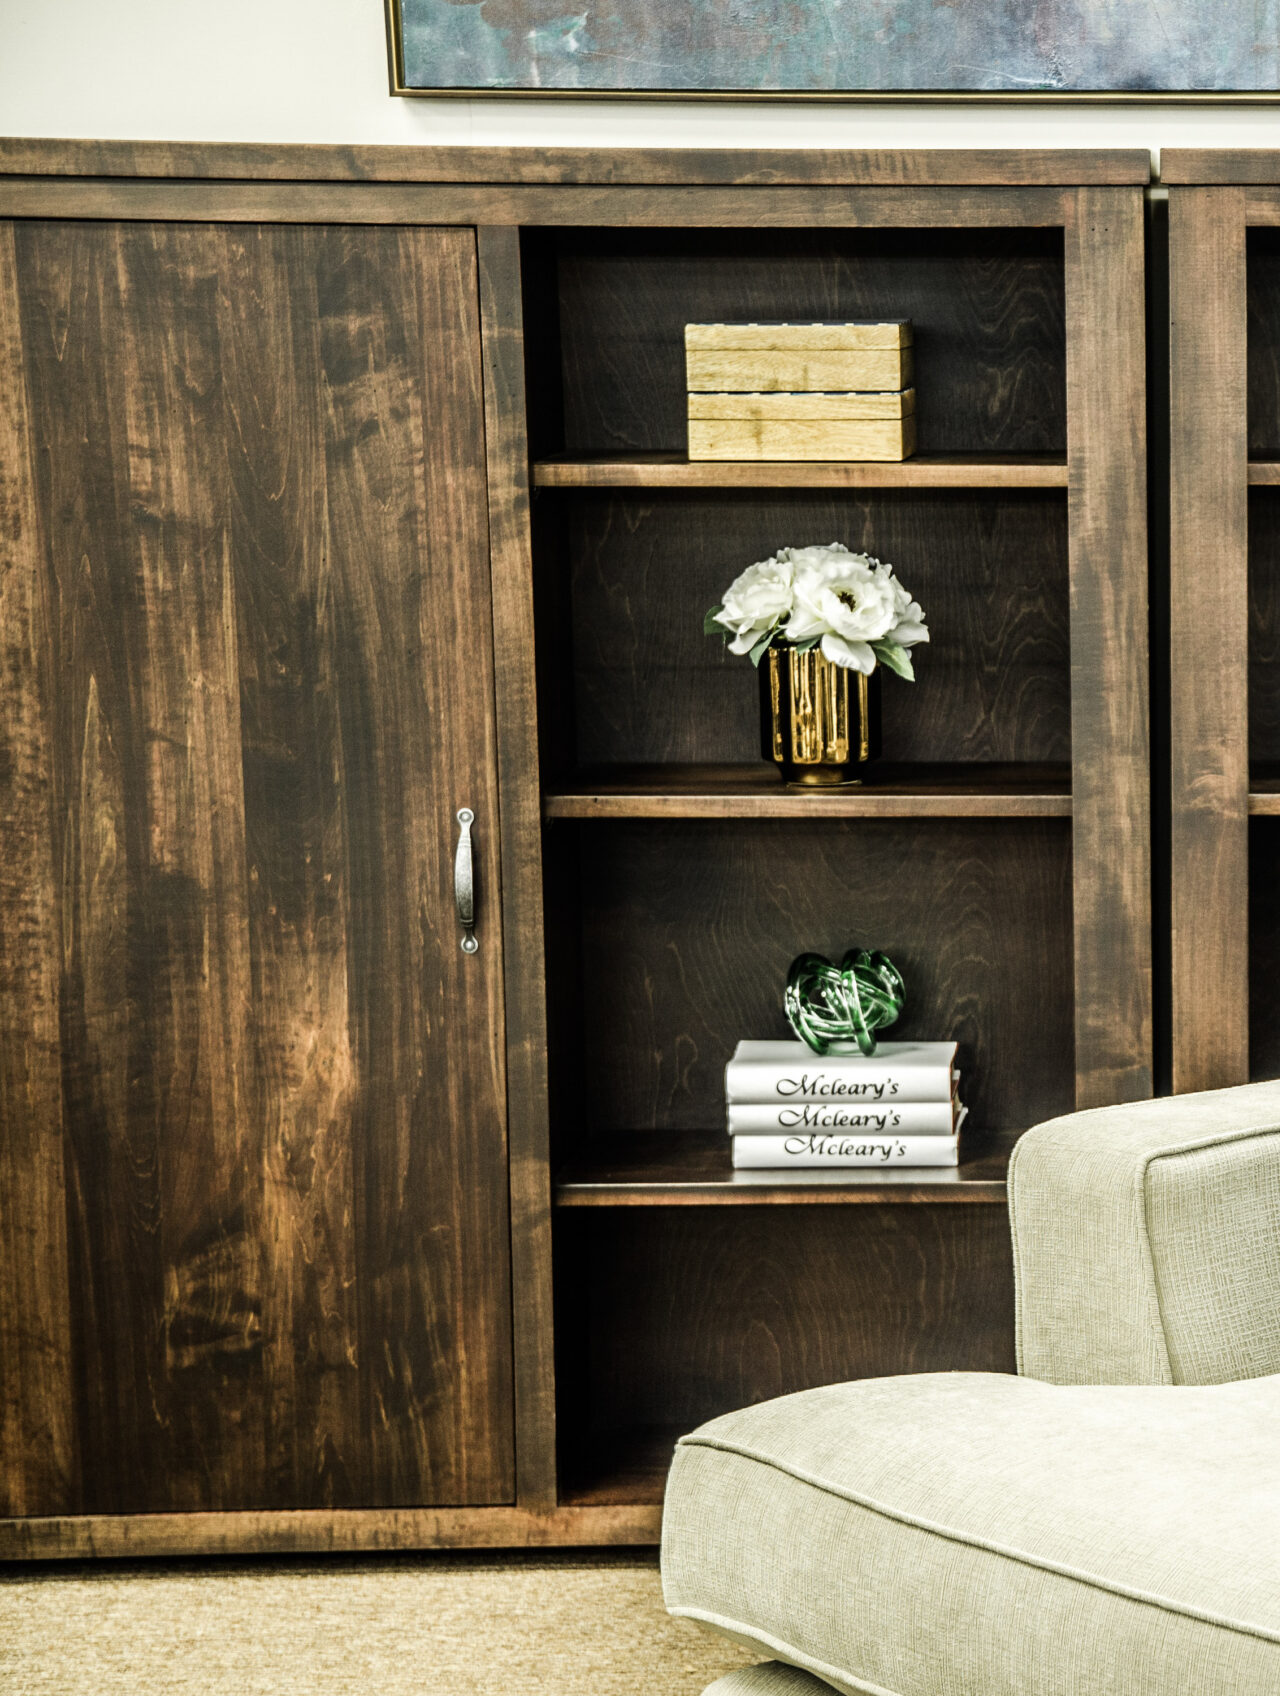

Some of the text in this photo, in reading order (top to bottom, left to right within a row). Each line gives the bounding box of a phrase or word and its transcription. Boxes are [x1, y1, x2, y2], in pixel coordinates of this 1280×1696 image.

[776, 1074, 899, 1099] Mcleary's
[778, 1105, 901, 1131] Mcleary's
[784, 1134, 906, 1161] Mcleary's
